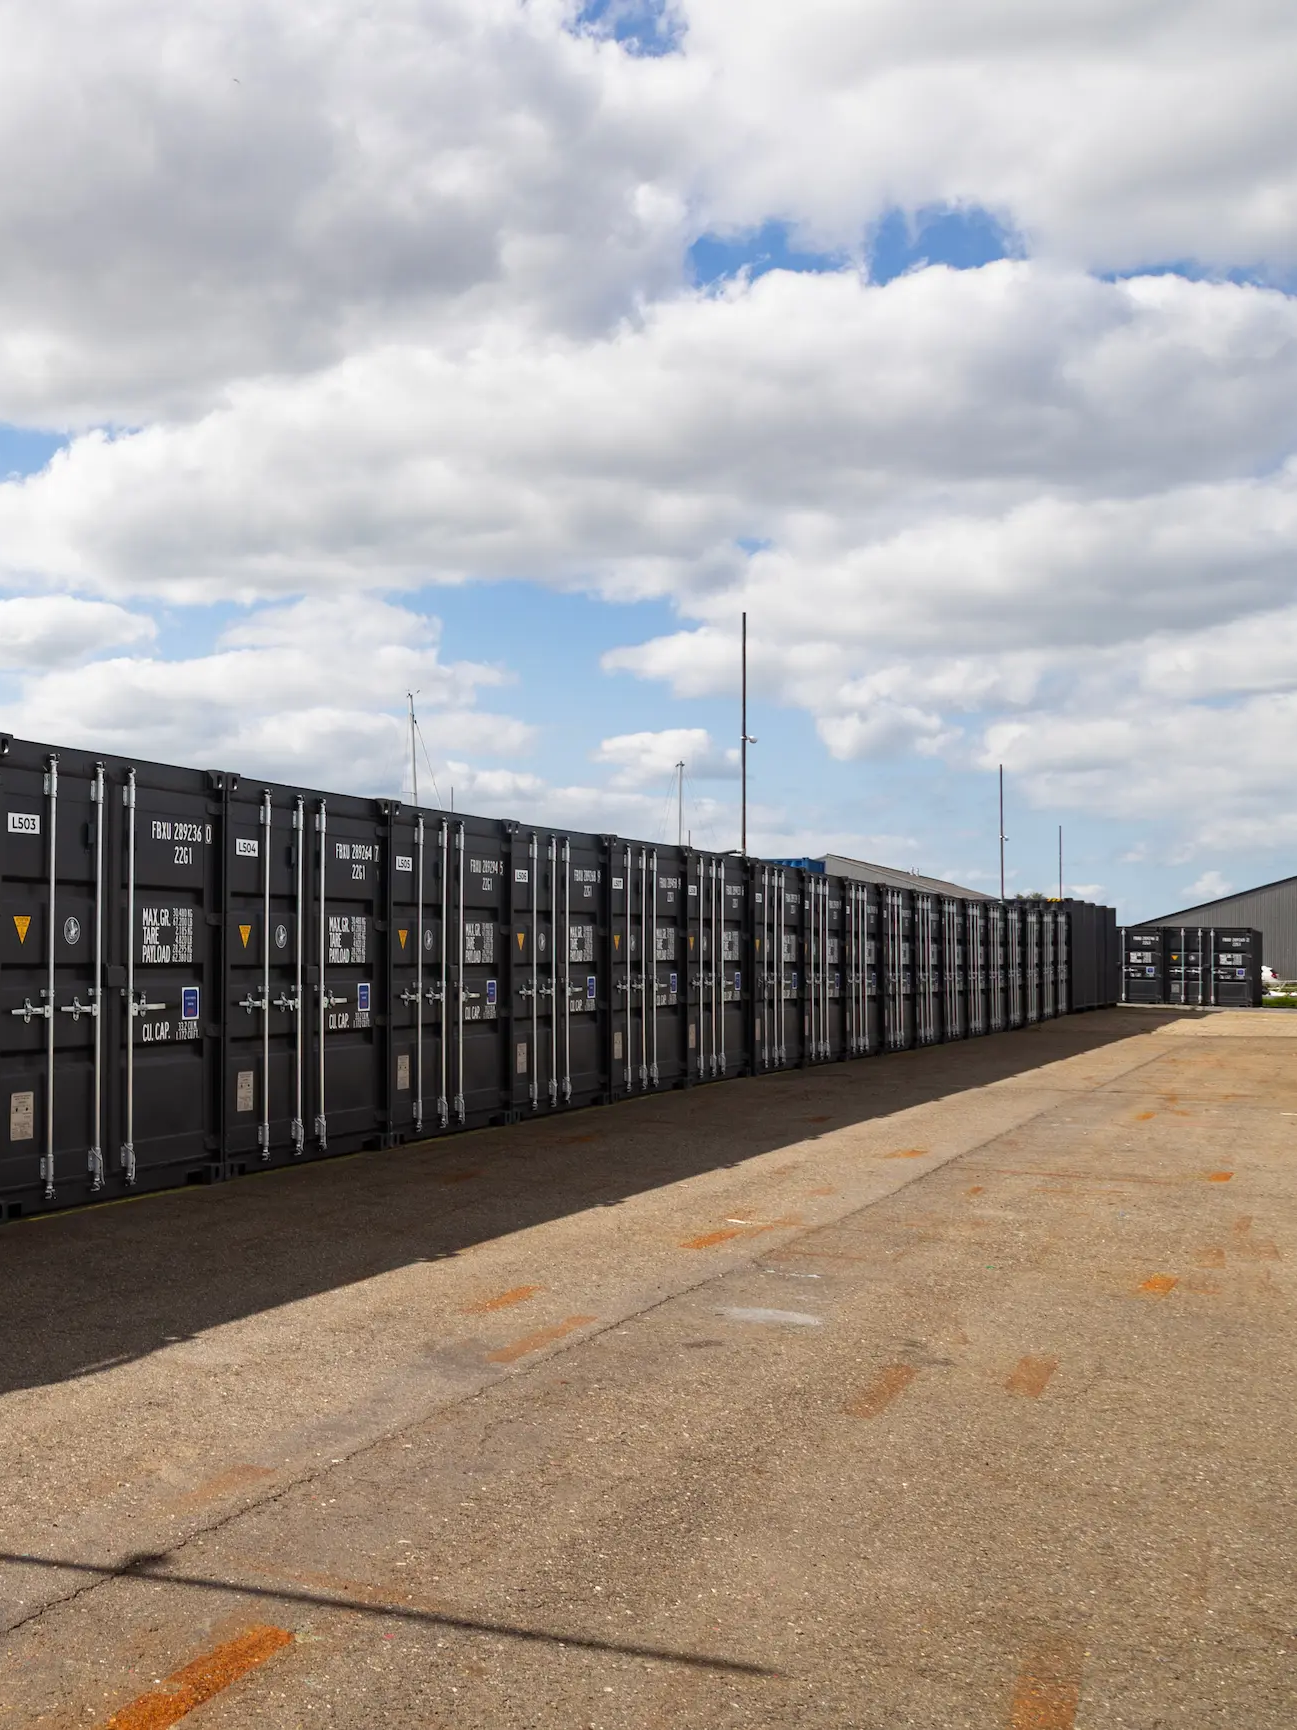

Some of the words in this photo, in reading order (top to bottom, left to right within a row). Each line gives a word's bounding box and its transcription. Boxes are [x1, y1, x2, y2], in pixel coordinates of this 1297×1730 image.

[12, 816, 36, 830] L503
[152, 820, 172, 840] FBXU
[174, 822, 202, 842] 289236
[205, 824, 212, 844] 0
[174, 846, 192, 864] 22G1
[239, 842, 256, 853] L504
[336, 843, 350, 860] FBXU
[352, 844, 372, 860] 289264
[398, 858, 410, 868] L505
[352, 864, 366, 880] 22G1
[142, 908, 160, 926] MAX.
[160, 908, 171, 926] GR.
[142, 926, 160, 944] TARE
[330, 932, 342, 948] TARE
[142, 944, 170, 963] PAYLOAD
[329, 948, 350, 963] PAYLOAD
[338, 1013, 350, 1028] CAP.
[142, 1024, 154, 1042] CU.
[155, 1022, 170, 1040] CAP.
